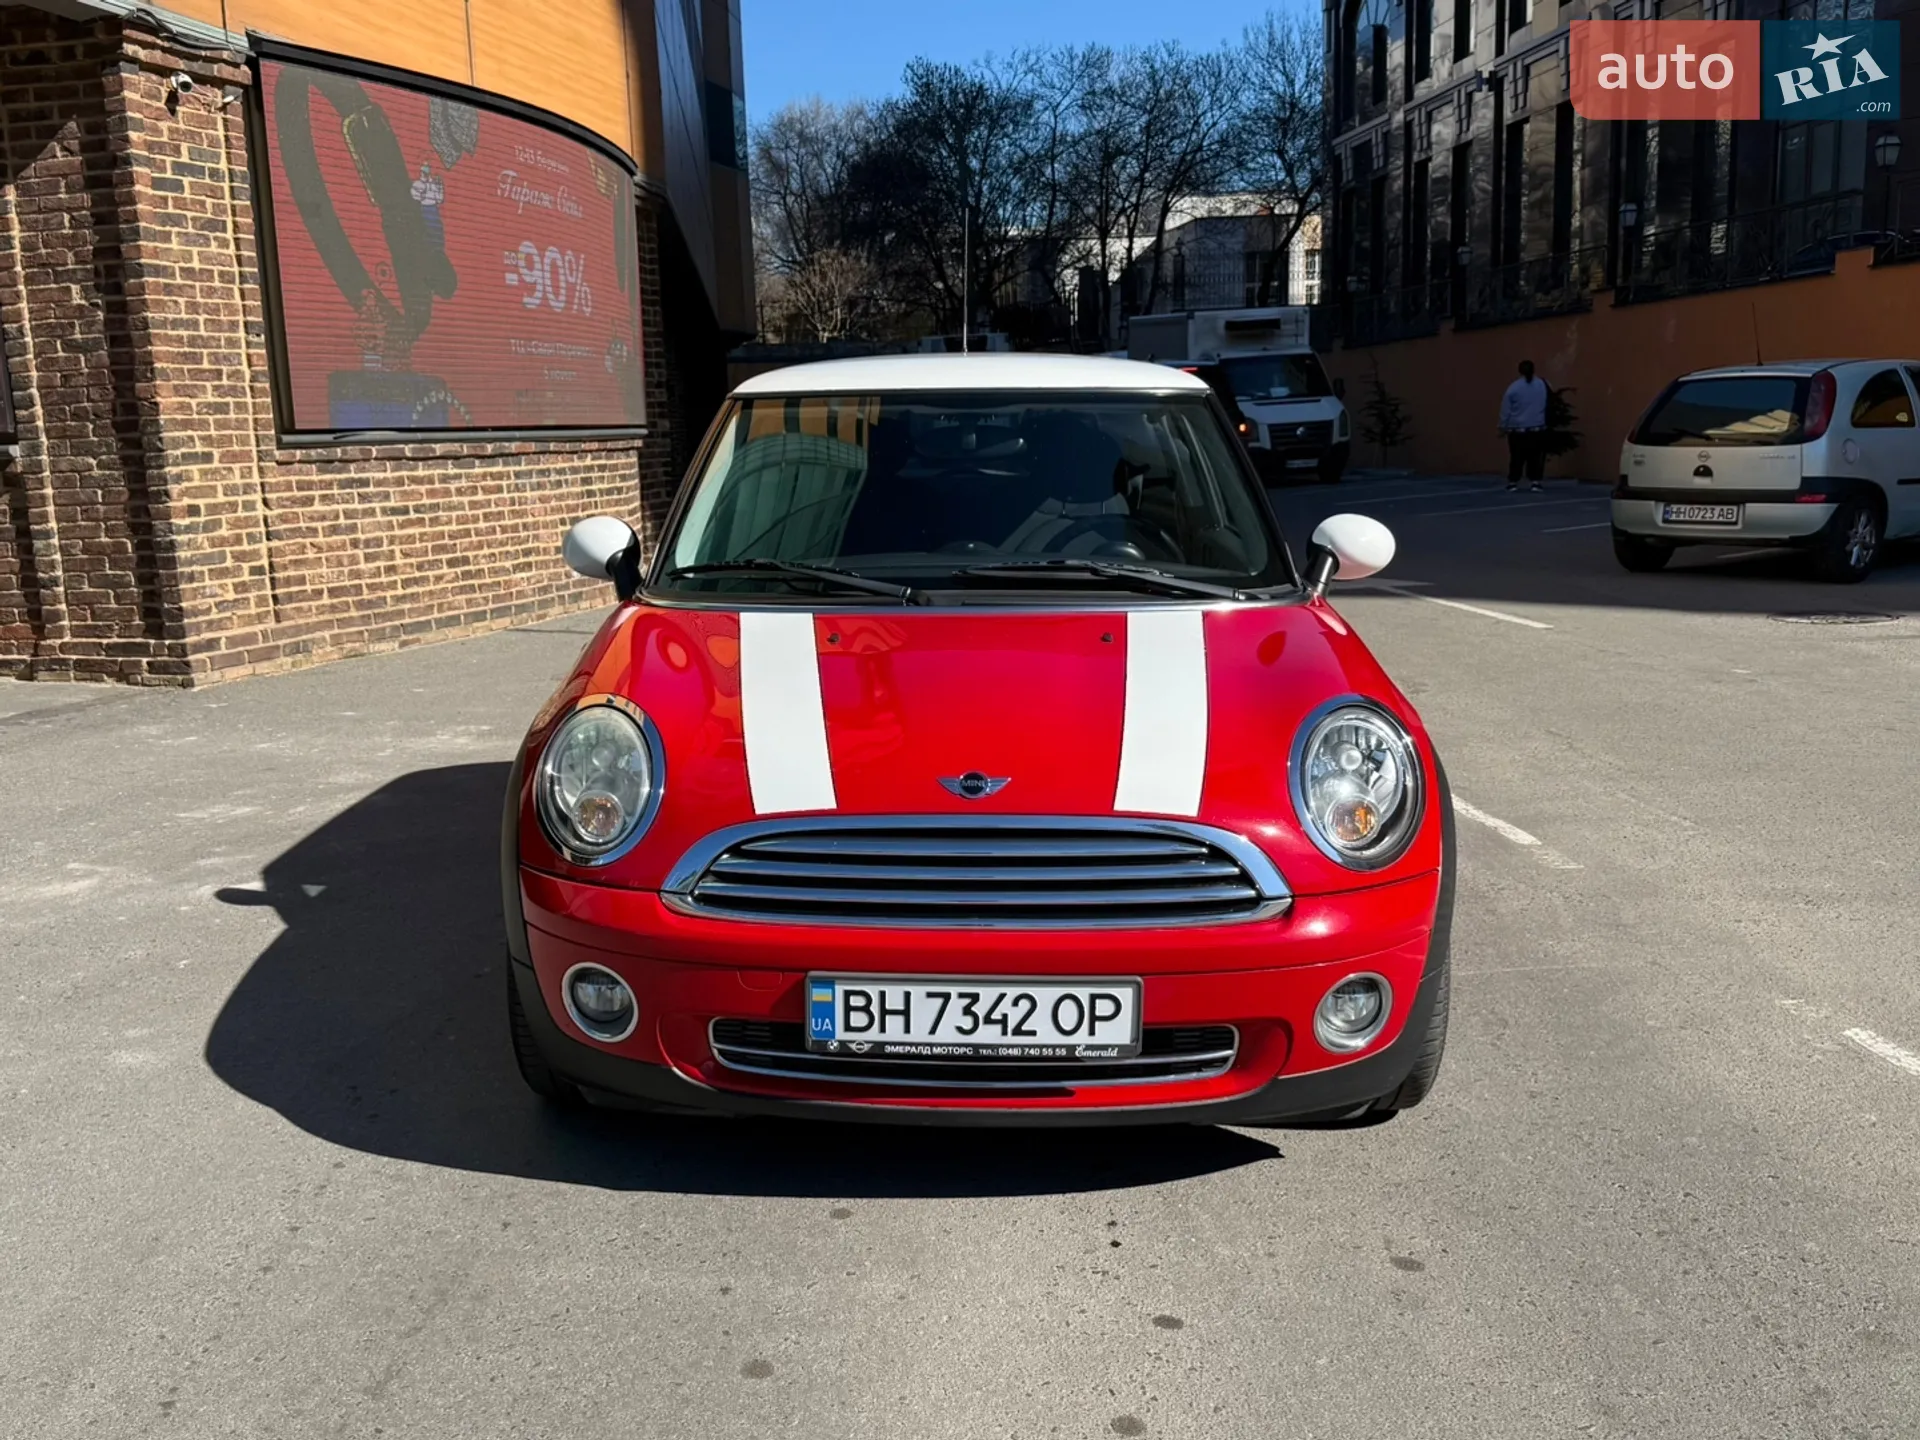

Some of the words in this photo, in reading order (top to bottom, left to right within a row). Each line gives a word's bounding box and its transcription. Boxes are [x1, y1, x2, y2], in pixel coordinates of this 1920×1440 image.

[505, 240, 592, 316] -90%
[1687, 507, 1716, 519] 0723
[1717, 508, 1734, 519] AB
[961, 779, 986, 787] MINI
[843, 989, 911, 1034] BH
[925, 991, 1038, 1036] 7342
[1051, 992, 1122, 1036] OP
[812, 1018, 833, 1031] UA
[884, 1044, 930, 1055] ЭМЕРАЛД
[932, 1046, 973, 1055] МОТОРС
[998, 1047, 1021, 1056] (048)
[1024, 1047, 1040, 1056] 740
[1042, 1047, 1053, 1056] 55
[1055, 1047, 1067, 1056] 55
[1075, 1043, 1118, 1057] Emerald
